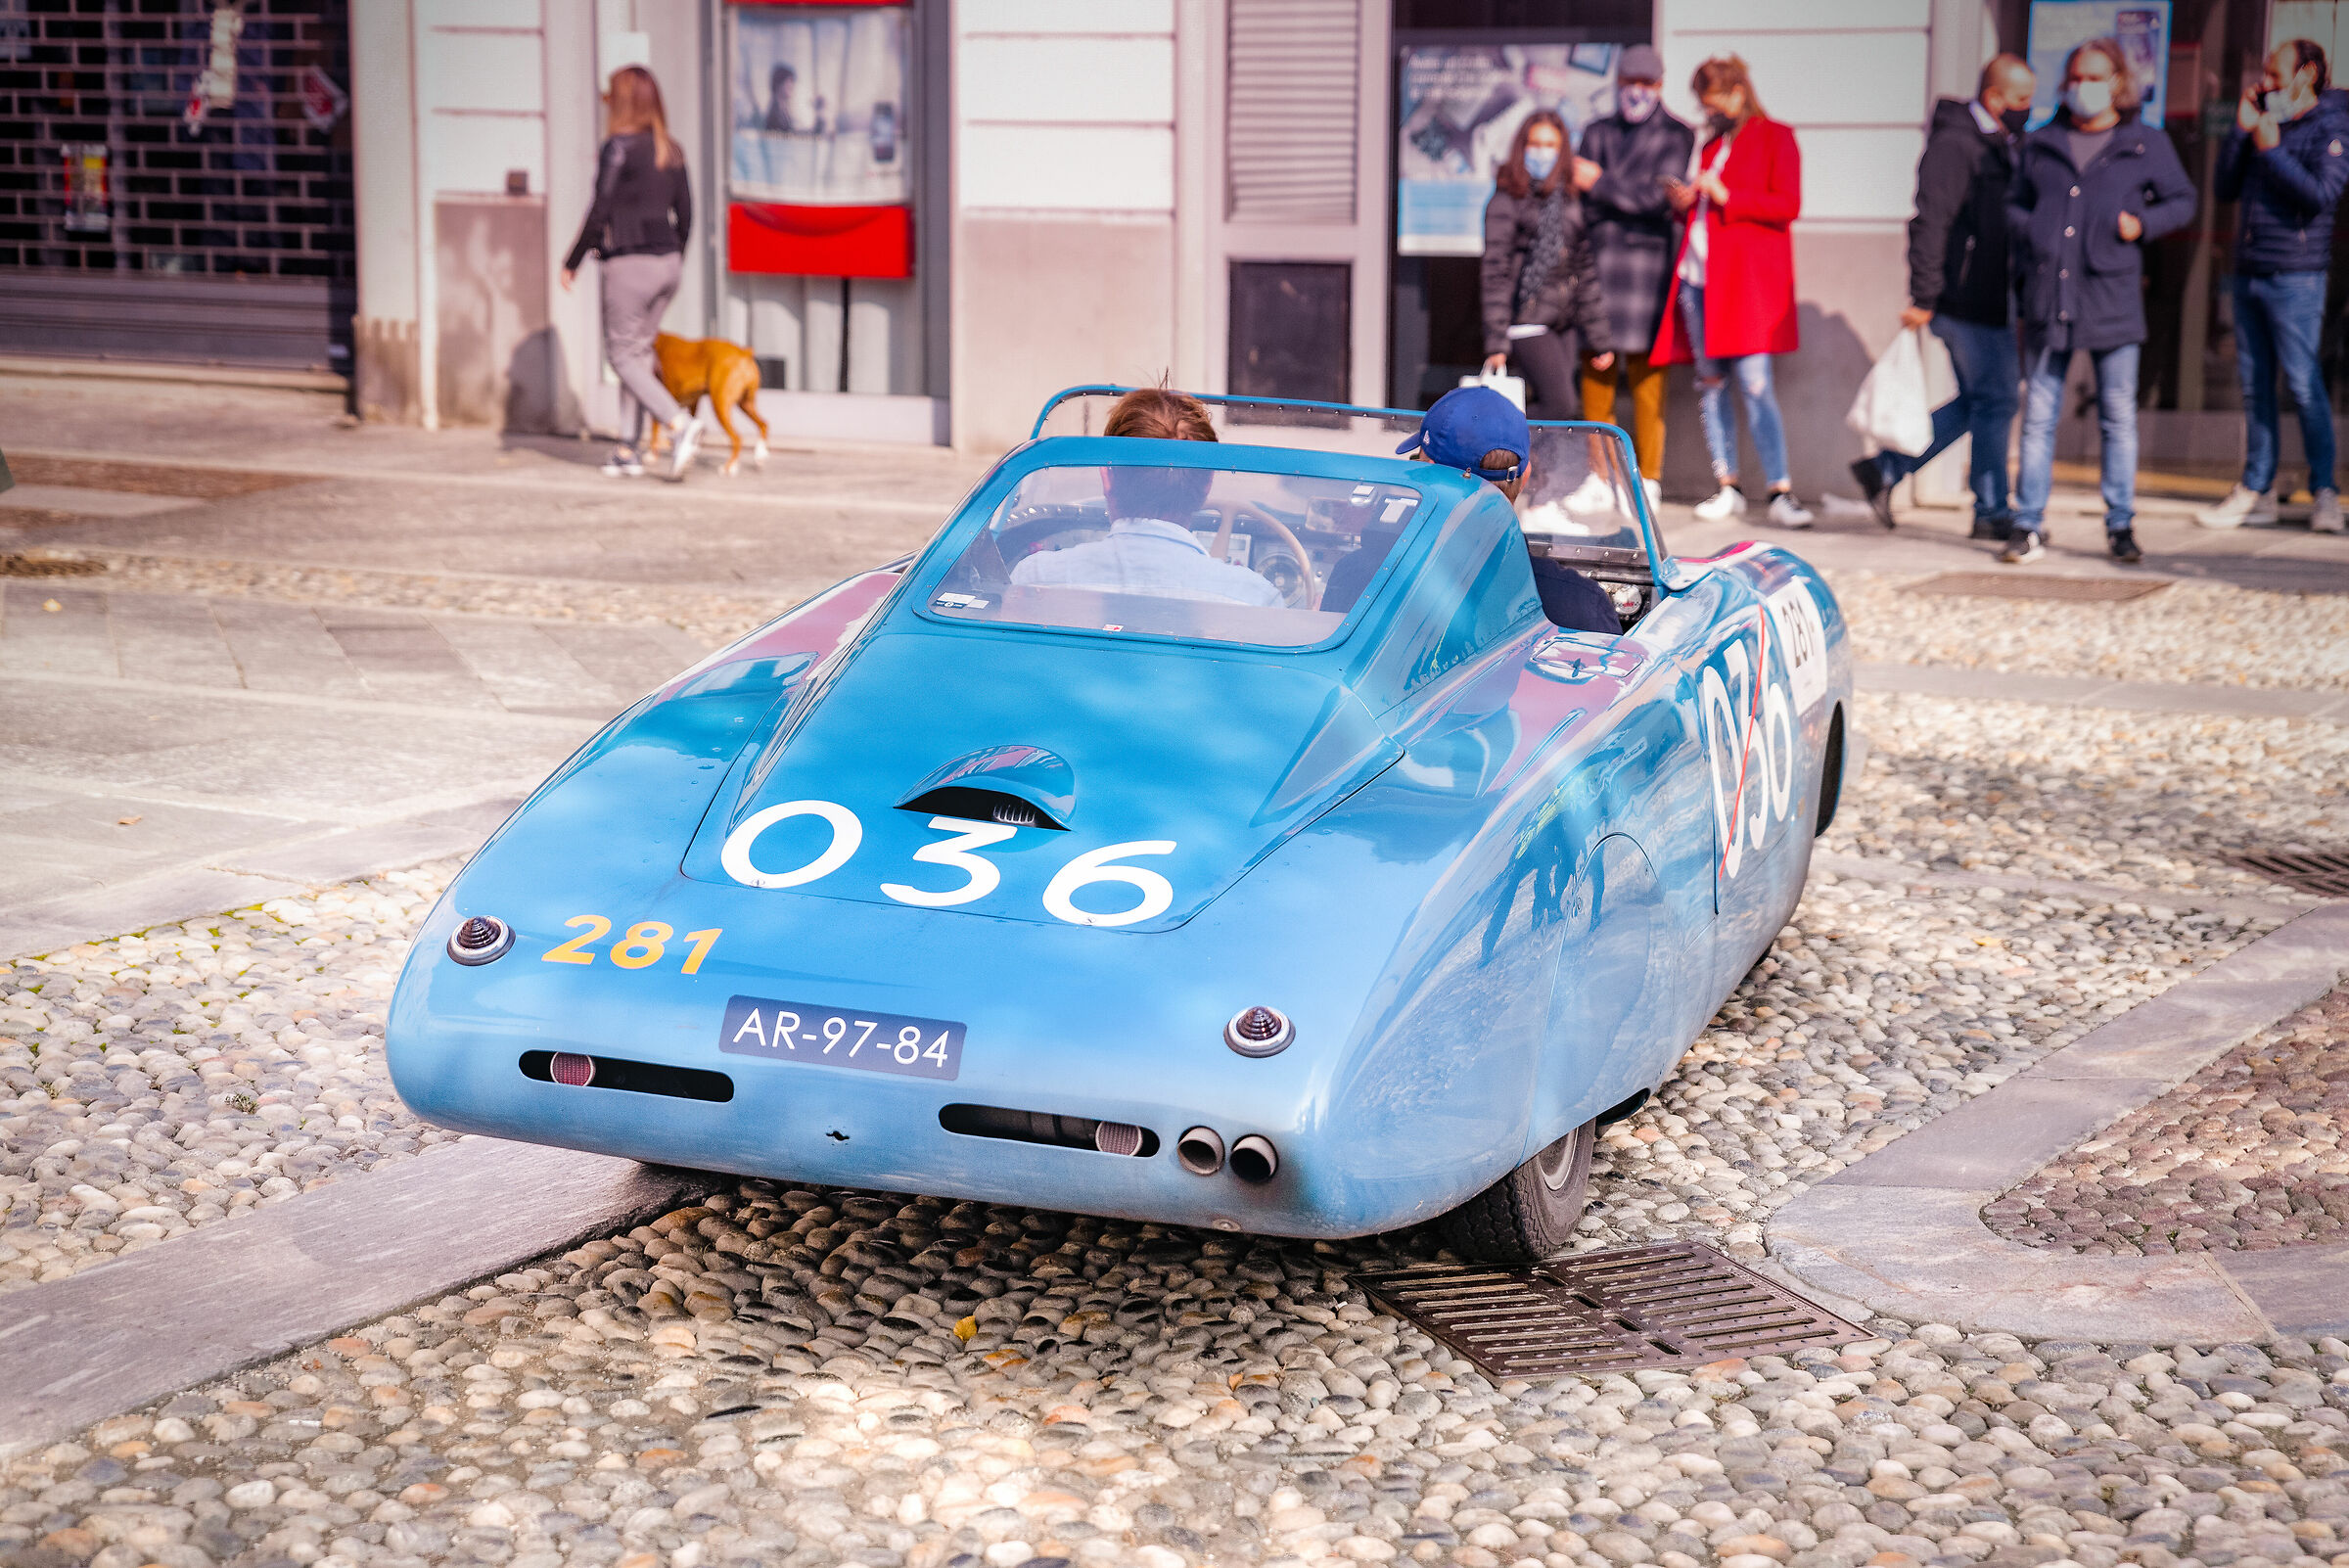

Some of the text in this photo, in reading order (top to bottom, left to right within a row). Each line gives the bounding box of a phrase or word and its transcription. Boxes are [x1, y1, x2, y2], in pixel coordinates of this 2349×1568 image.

[720, 800, 1176, 927] 036
[541, 914, 722, 974] 281
[732, 1007, 949, 1069] AR-97-84
